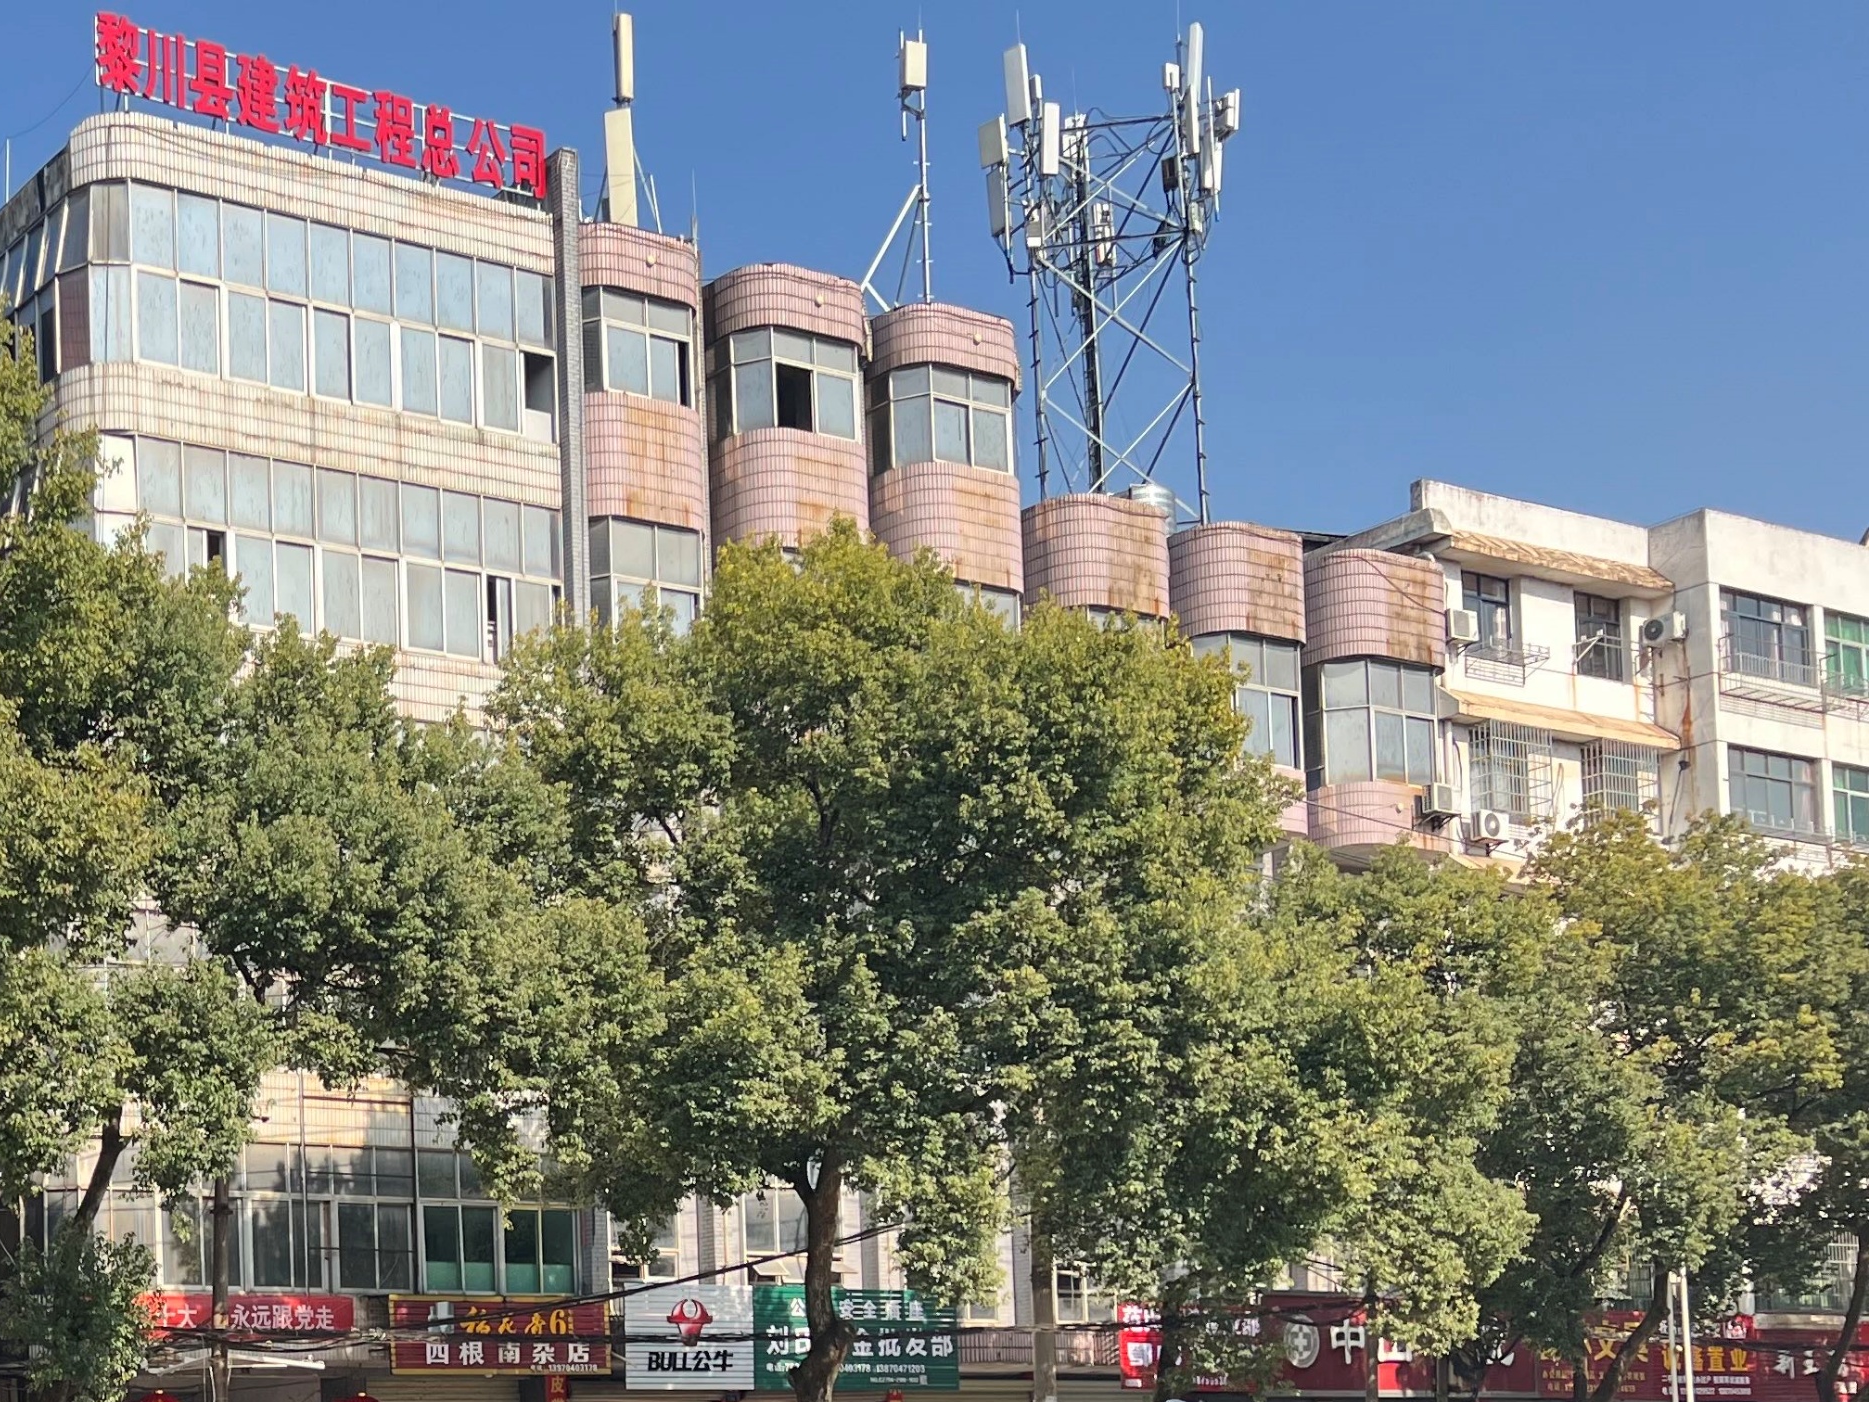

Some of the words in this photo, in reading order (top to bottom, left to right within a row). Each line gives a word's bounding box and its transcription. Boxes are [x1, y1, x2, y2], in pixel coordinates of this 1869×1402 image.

[96, 12, 547, 199] 黎川县建筑工程总公司
[230, 1303, 335, 1331] 永远跟党走
[790, 1297, 925, 1321] 公安全插座
[425, 1341, 590, 1366] 四根南杂店
[648, 1350, 734, 1373] BULL公牛
